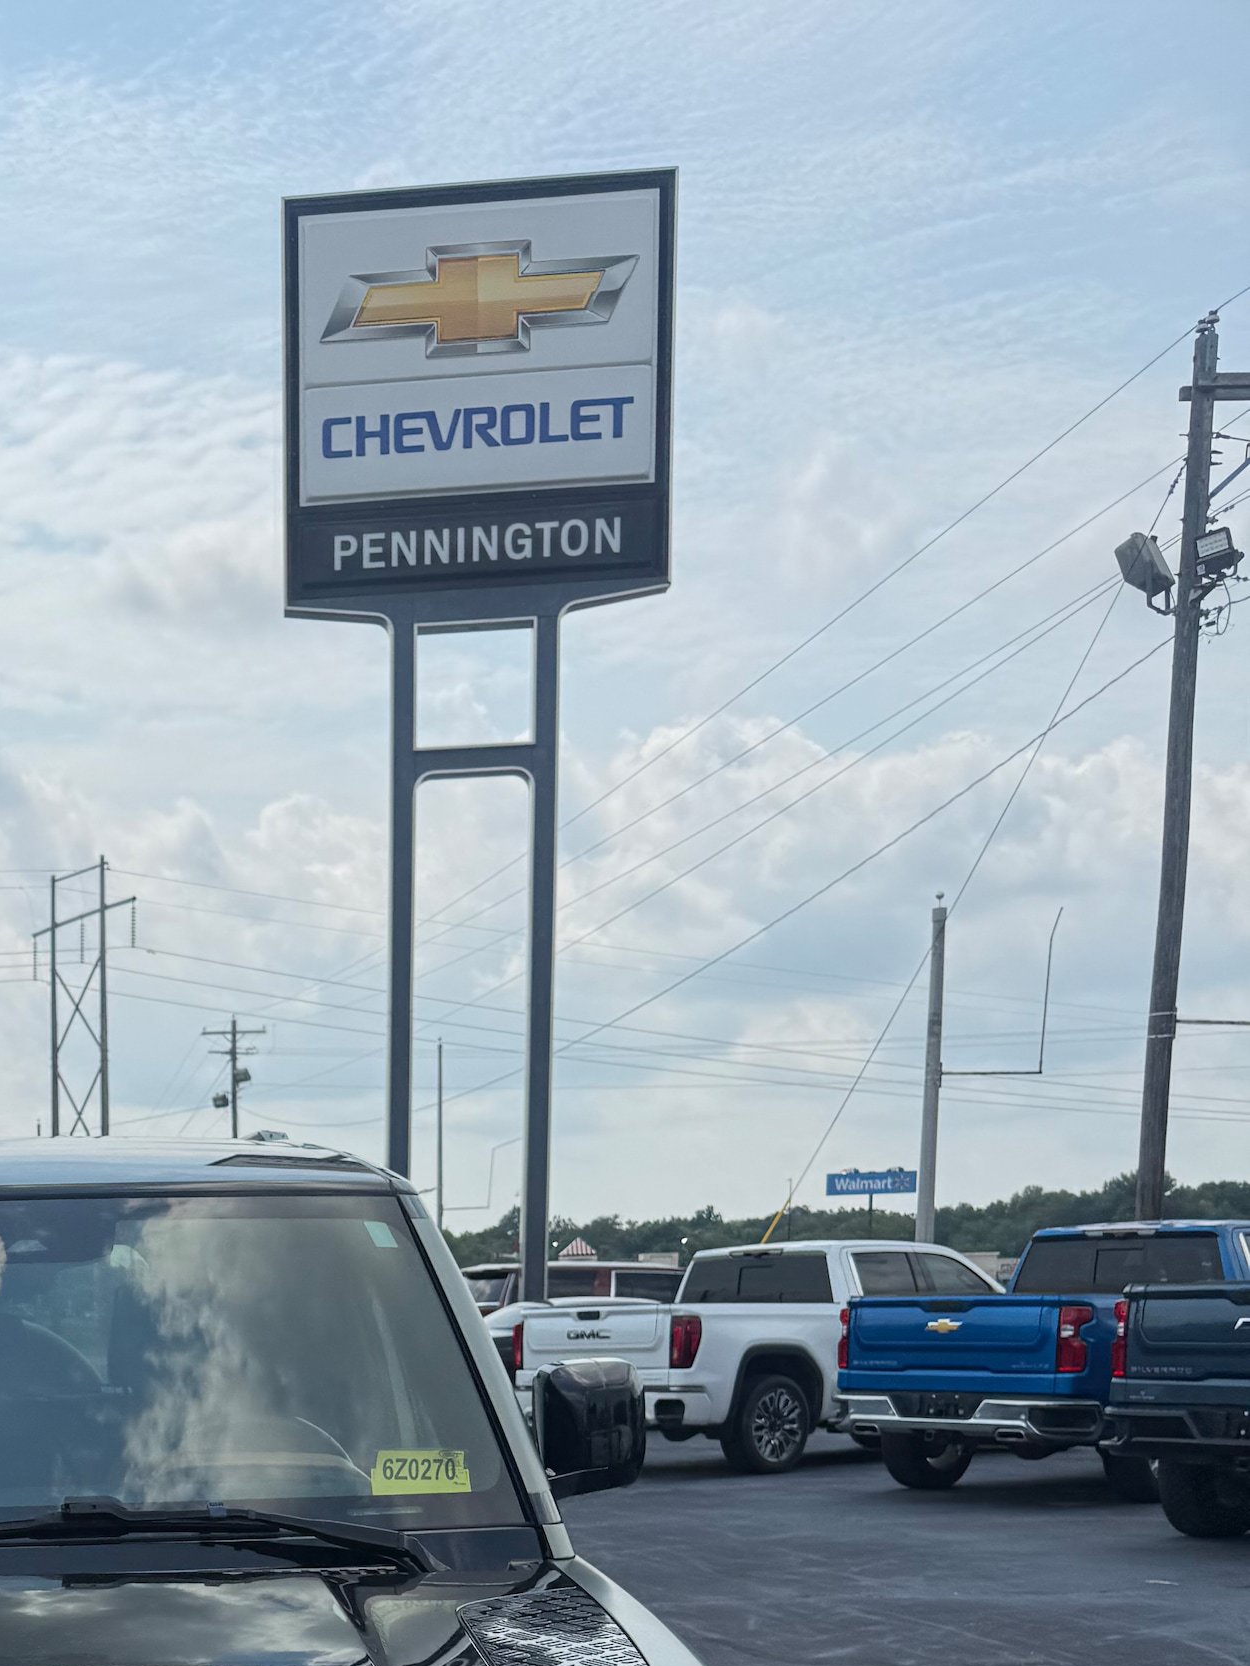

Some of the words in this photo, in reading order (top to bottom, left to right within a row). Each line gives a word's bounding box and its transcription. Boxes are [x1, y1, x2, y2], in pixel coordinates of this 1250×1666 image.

[322, 396, 634, 459] CHEVROLET
[333, 517, 622, 571] PENNINGTON
[835, 1176, 892, 1191] Walmart
[567, 1329, 611, 1340] GMC
[383, 1458, 455, 1480] 6Z0270
